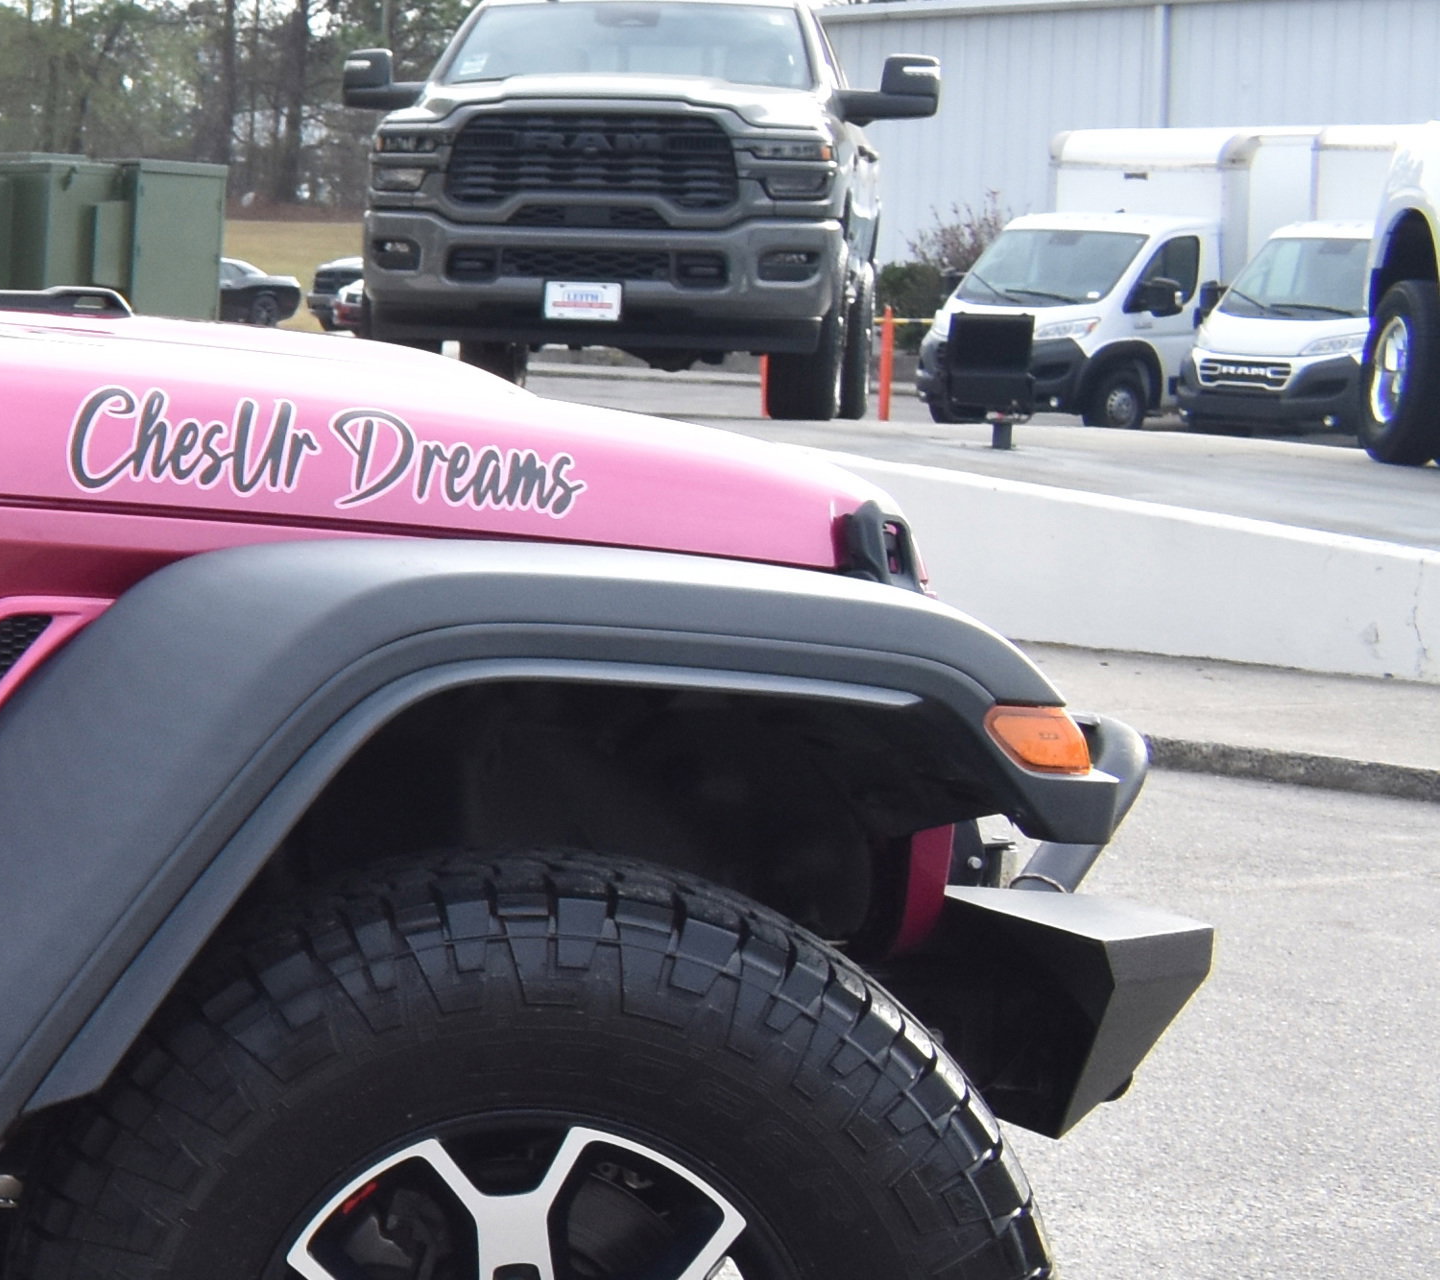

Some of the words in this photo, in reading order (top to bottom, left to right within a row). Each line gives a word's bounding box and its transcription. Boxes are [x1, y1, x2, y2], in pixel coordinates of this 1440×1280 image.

[522, 131, 662, 150] RAM
[1221, 365, 1266, 376] RAM
[69, 386, 320, 493] ChesUr
[330, 408, 586, 517] Dreams
